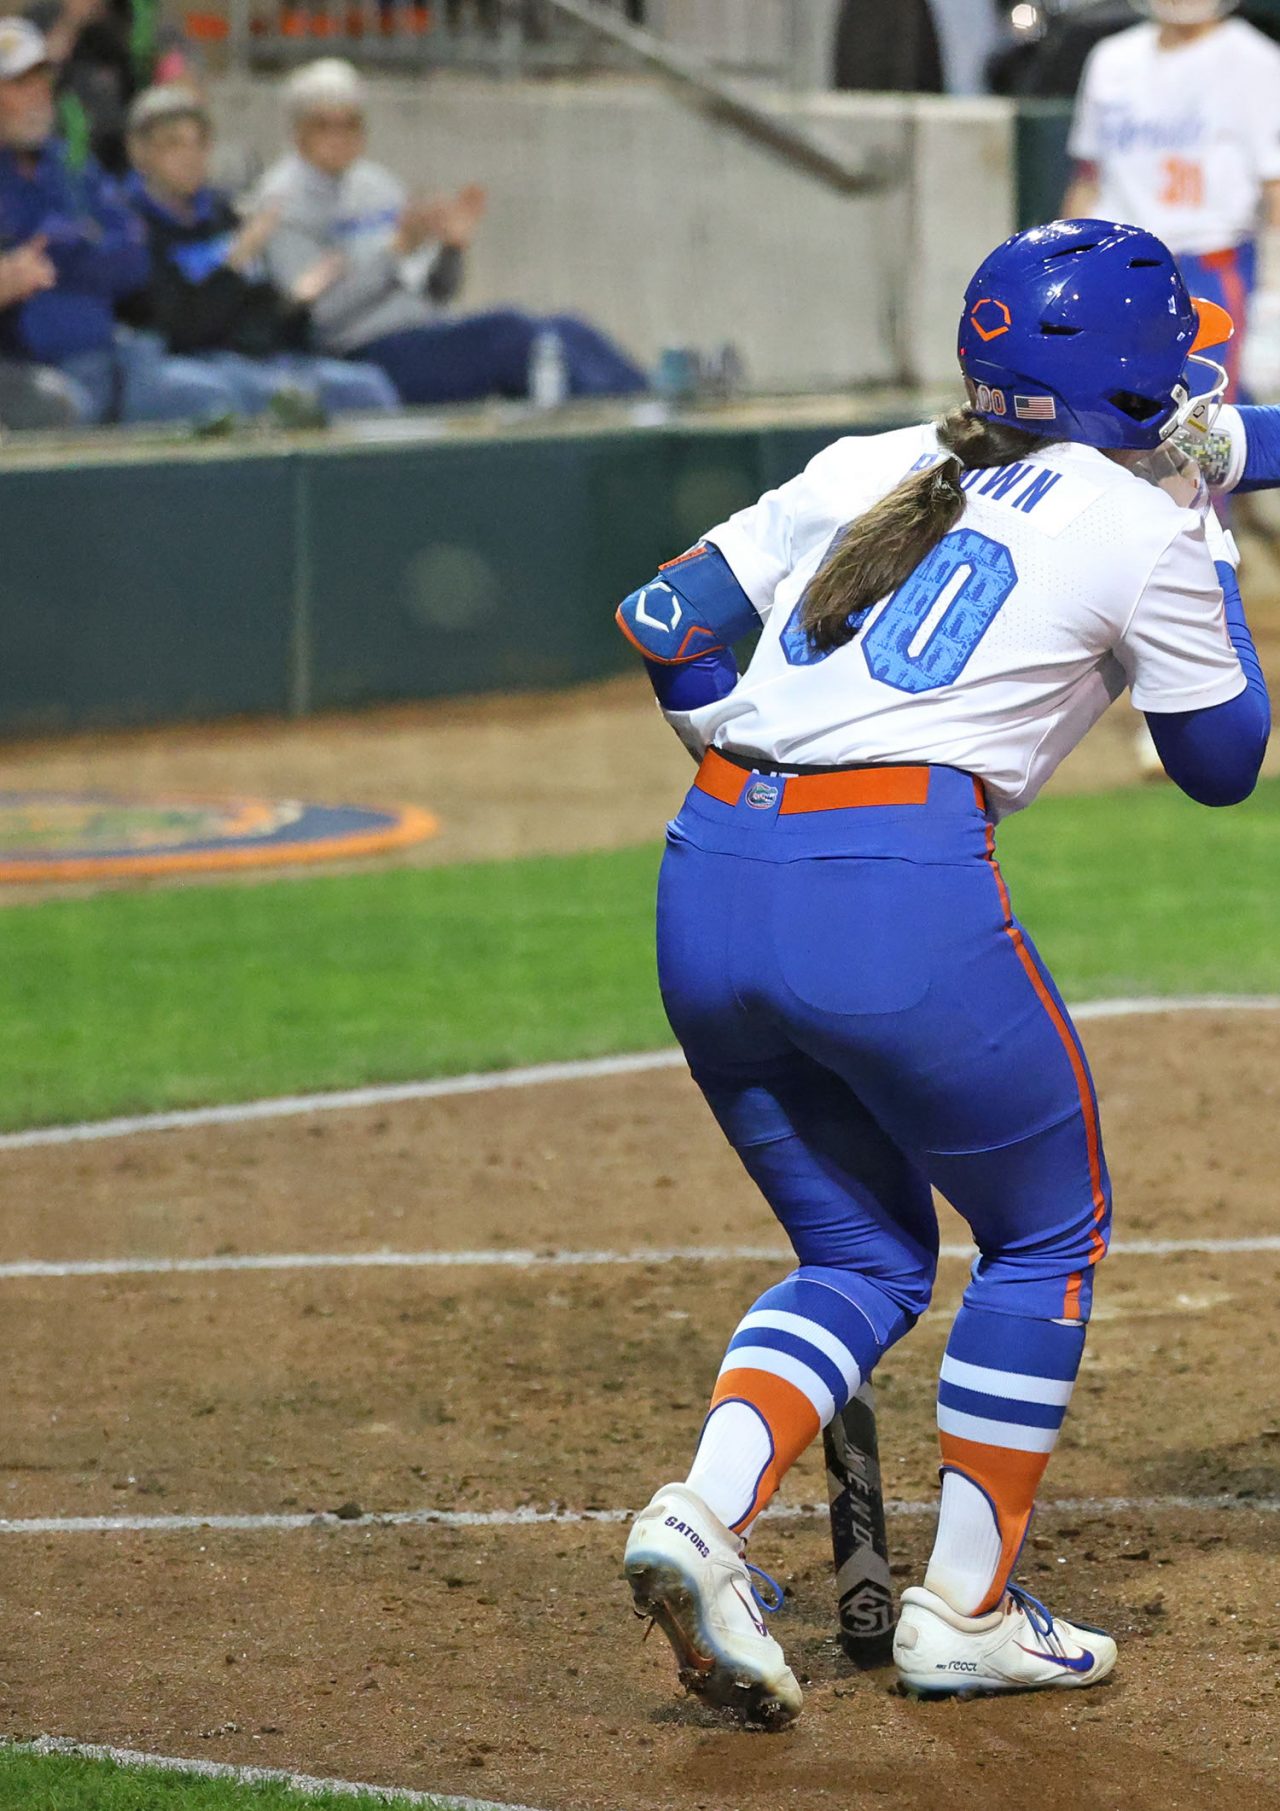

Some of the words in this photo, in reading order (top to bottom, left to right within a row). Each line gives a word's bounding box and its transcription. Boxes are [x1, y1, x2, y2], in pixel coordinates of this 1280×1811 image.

[908, 453, 1063, 514] OWN
[780, 526, 1018, 694] 0
[664, 1516, 710, 1558] GATORS
